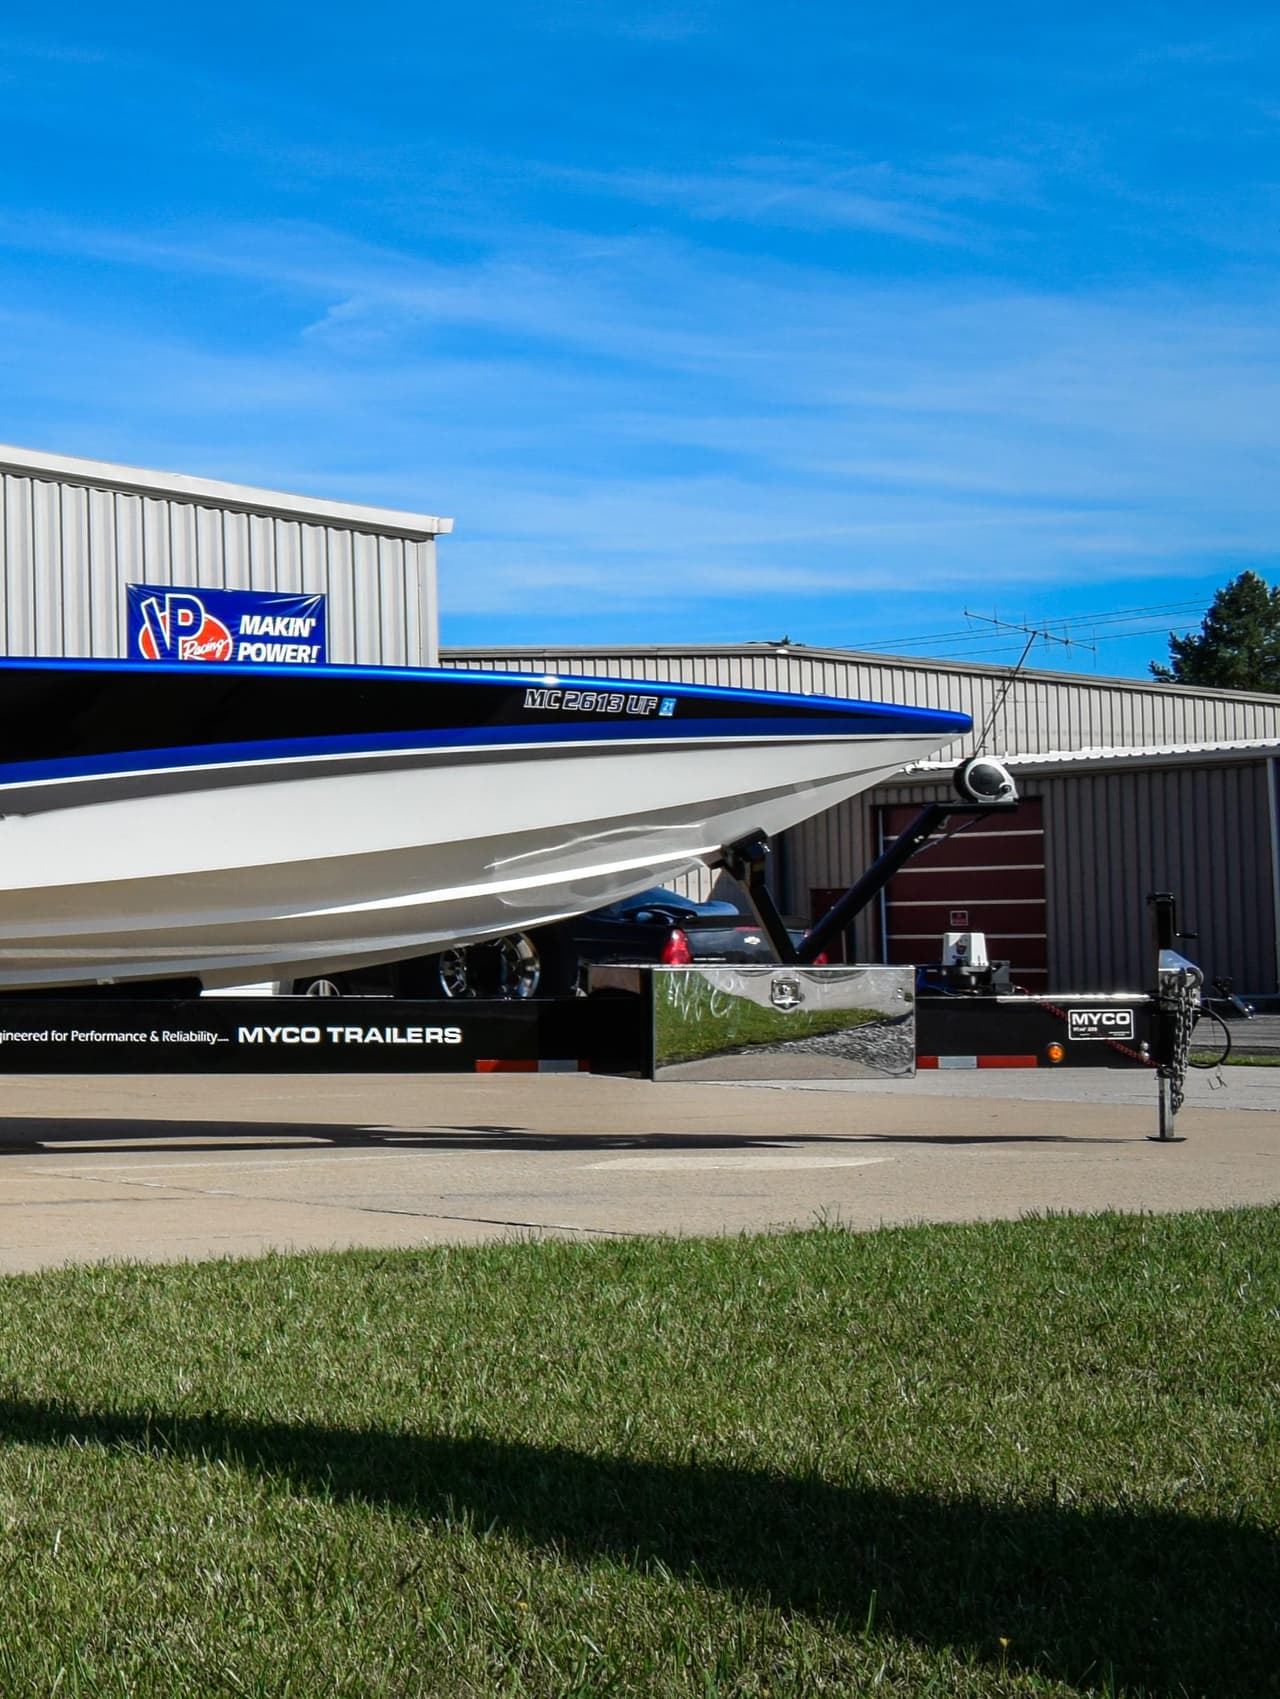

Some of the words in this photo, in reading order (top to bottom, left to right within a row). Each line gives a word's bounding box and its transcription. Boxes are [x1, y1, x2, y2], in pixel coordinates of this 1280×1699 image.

[141, 593, 206, 660] VP
[240, 615, 317, 638] MAKIN'
[182, 636, 229, 658] Racing
[238, 643, 322, 663] POWER!
[524, 689, 561, 710] MC
[562, 691, 624, 713] 2613
[626, 695, 658, 715] UF
[1071, 1012, 1130, 1026] MYCO
[51, 1029, 68, 1042] for
[71, 1030, 147, 1042] Performance
[149, 1031, 159, 1042] &
[238, 1027, 321, 1044] MYCO
[326, 1027, 462, 1044] TRAILERS
